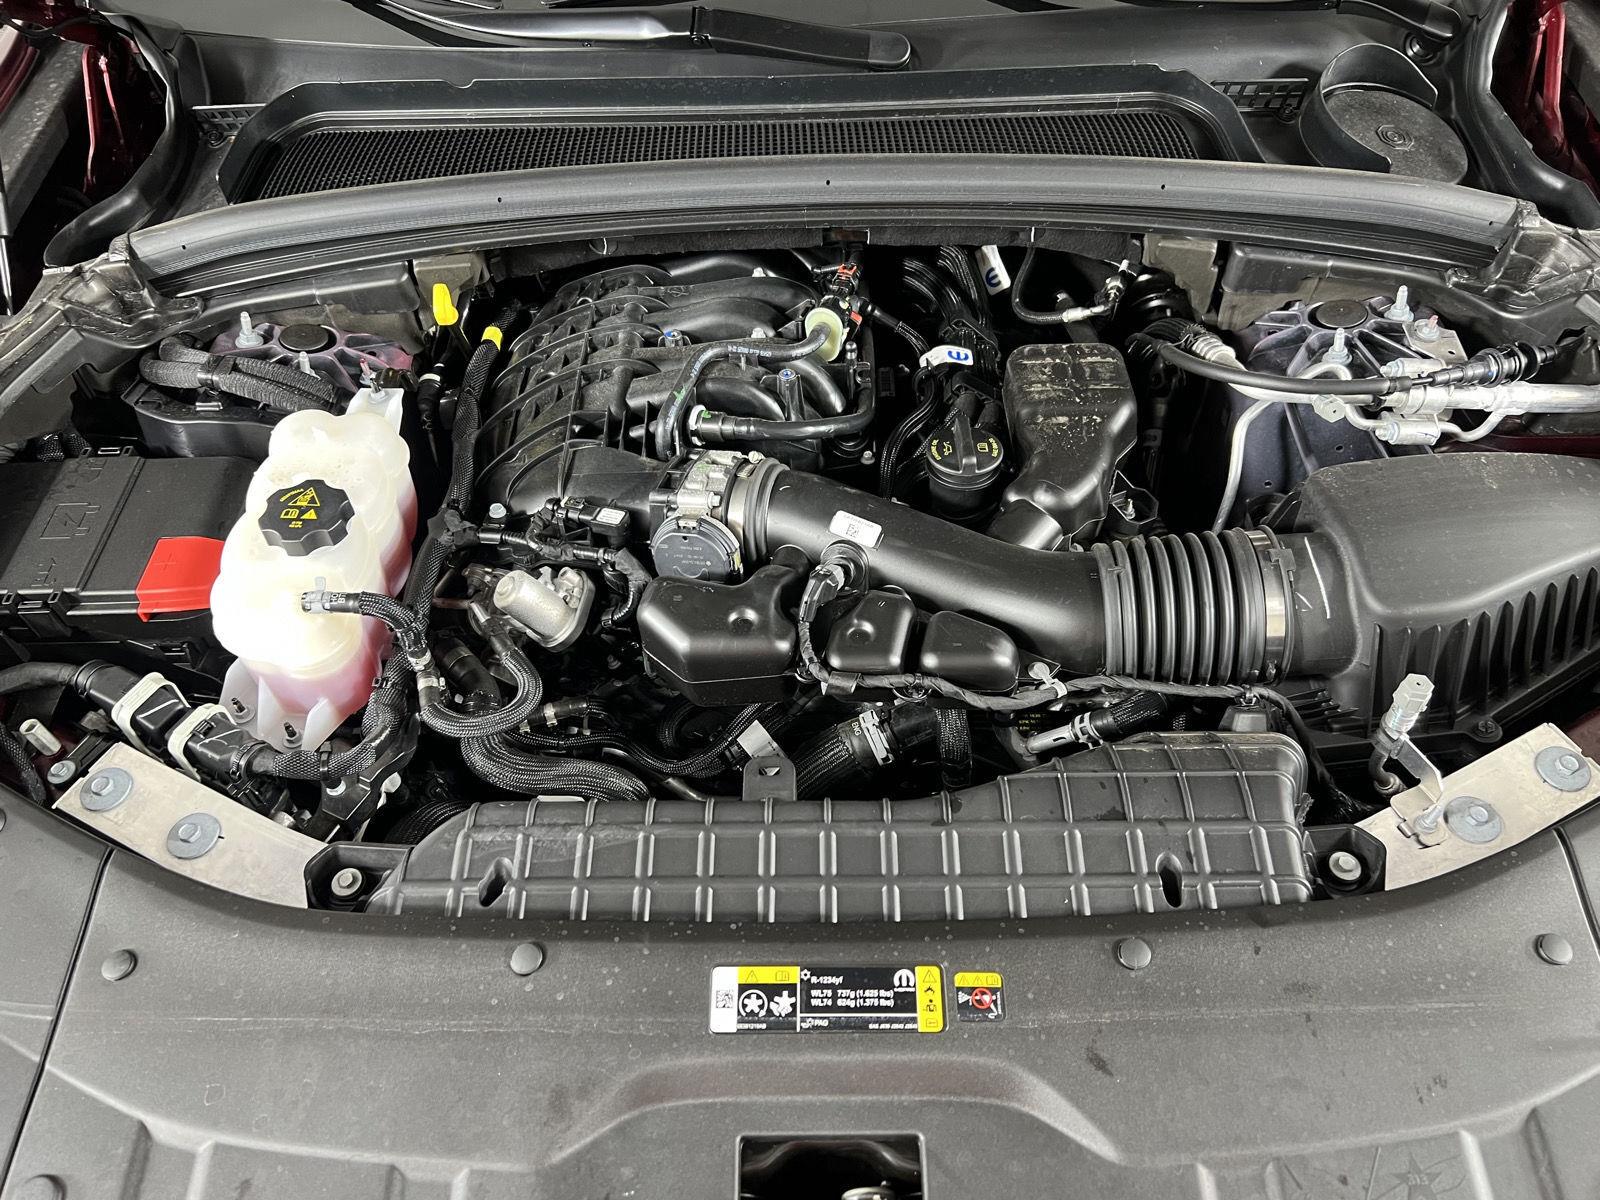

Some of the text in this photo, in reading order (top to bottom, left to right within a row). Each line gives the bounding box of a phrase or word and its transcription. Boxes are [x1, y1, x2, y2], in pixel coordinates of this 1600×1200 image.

[851, 721, 862, 736] ENG
[810, 989, 832, 998] WL75
[879, 989, 894, 998] lbs)
[810, 998, 832, 1007] WL74
[879, 998, 894, 1008] lbs)
